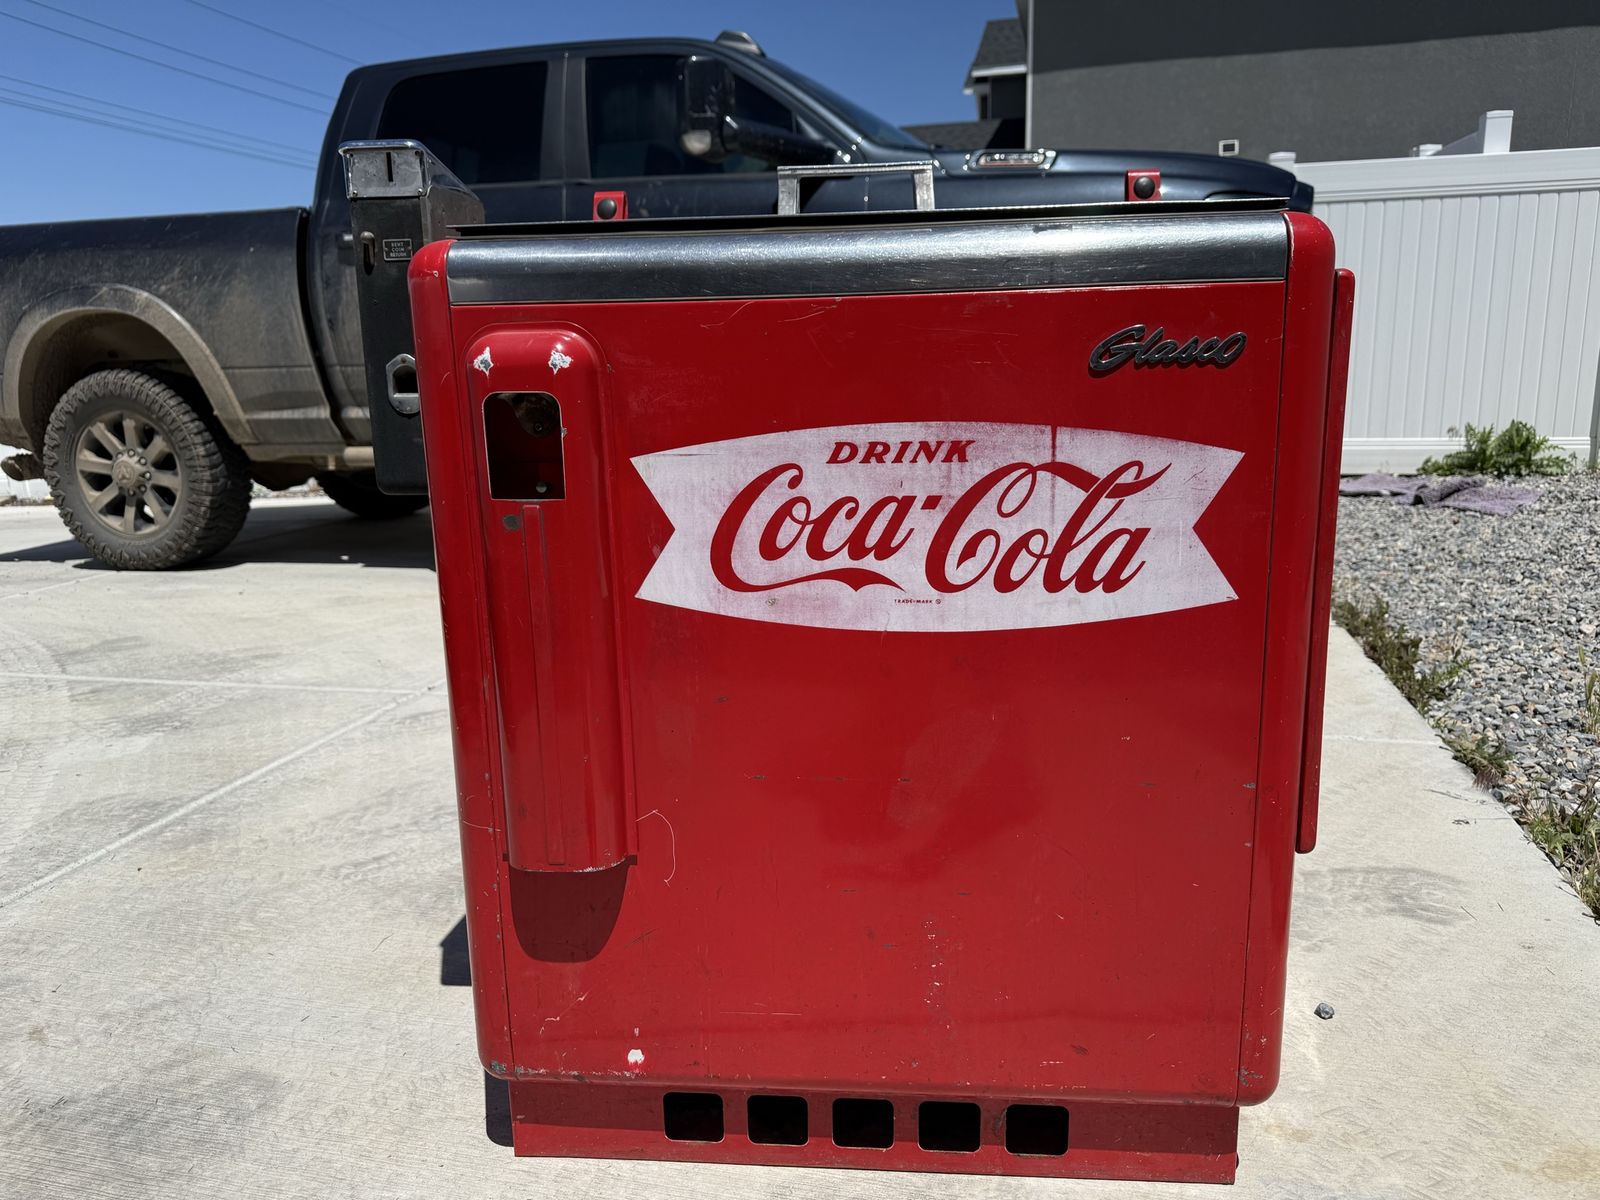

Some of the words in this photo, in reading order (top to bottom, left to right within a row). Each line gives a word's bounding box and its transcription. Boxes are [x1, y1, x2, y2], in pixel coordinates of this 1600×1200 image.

[1089, 323, 1248, 371] Glasco
[826, 440, 976, 464] DRINK
[709, 461, 1173, 594] Coca-Cola
